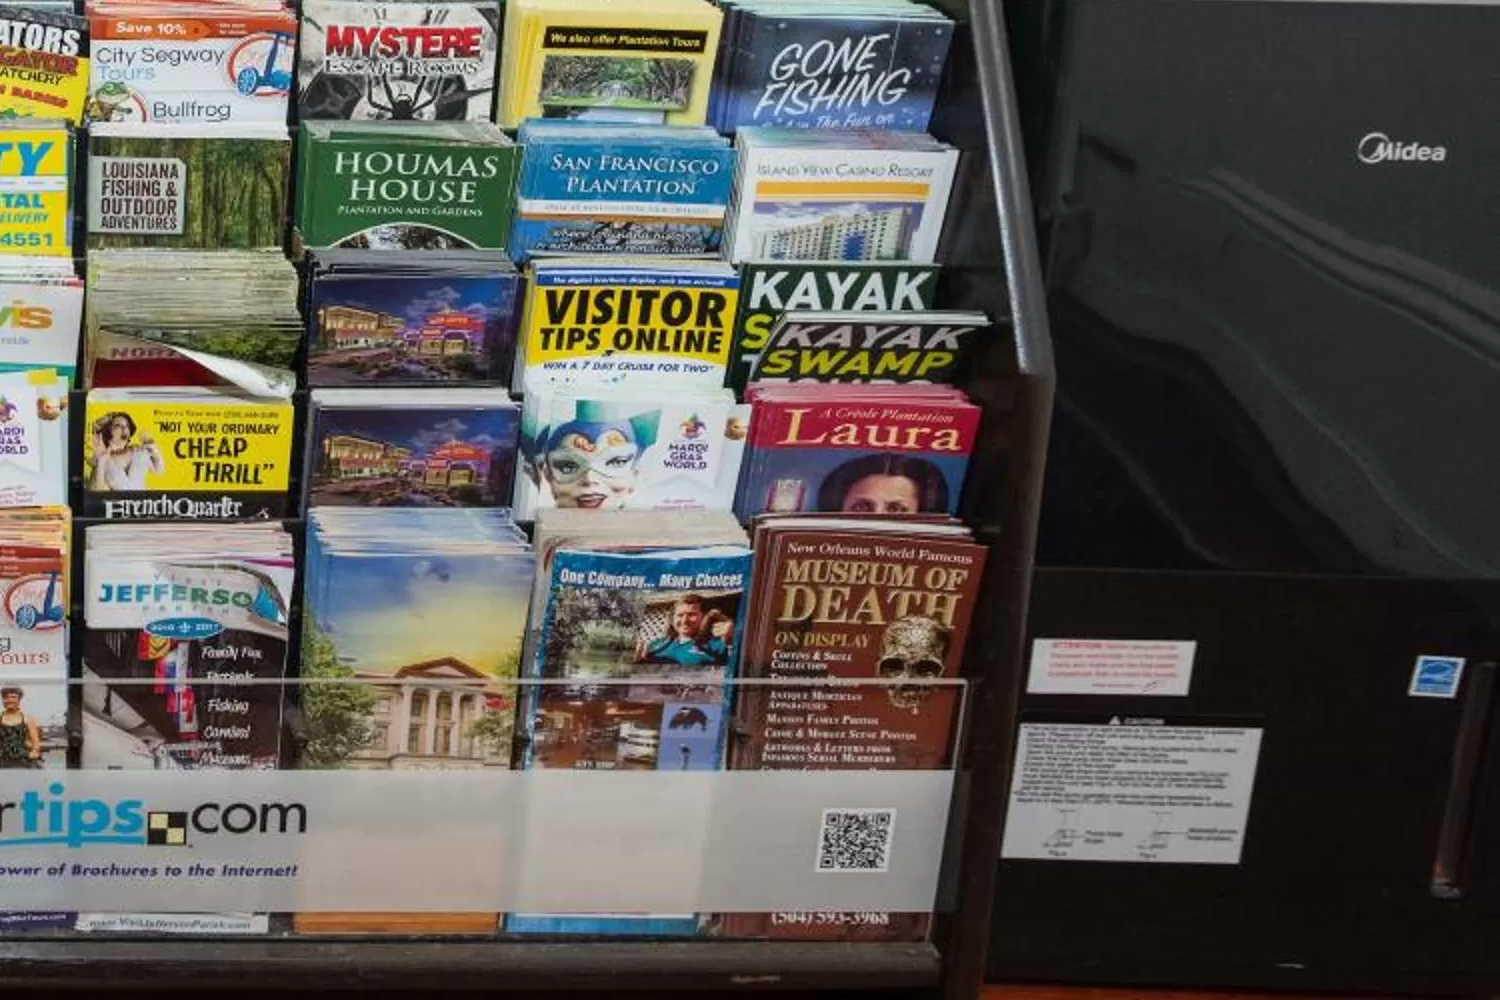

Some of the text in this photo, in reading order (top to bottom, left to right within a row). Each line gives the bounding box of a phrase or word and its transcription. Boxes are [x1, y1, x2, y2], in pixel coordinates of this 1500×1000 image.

[116, 22, 188, 36] Save 10%
[325, 25, 484, 59] MYSTERE
[550, 33, 702, 48] We also offer Plantation Tours
[96, 47, 226, 71] City Segway
[152, 101, 232, 120] Bullfrog
[1357, 131, 1448, 165] Midea
[101, 160, 180, 180] LOUISIANA
[334, 151, 499, 179] HOUMAS
[551, 153, 719, 175] SAN FRANCISCO
[101, 180, 178, 198] FISHING &
[347, 178, 478, 203] HOUSE
[565, 175, 697, 196] PLANTATION
[100, 199, 178, 217] OUTDOOR
[337, 205, 483, 218] PLANTATION AND GARDENS
[99, 217, 178, 231] ADVENTURES
[748, 270, 933, 311] KAYAK
[543, 289, 728, 328] VISITOR
[539, 328, 725, 354] TIPS ONLINE
[776, 408, 962, 452] Laura
[560, 569, 743, 590] One Company... Many Choices
[784, 558, 969, 591] MUSEUM OF
[778, 585, 963, 630] DEATH
[774, 631, 870, 649] ON DISPLAY
[46, 862, 66, 877] of
[70, 862, 158, 878] Brochures
[164, 863, 182, 878] to
[187, 862, 216, 878] the
[221, 862, 298, 878] Internet!
